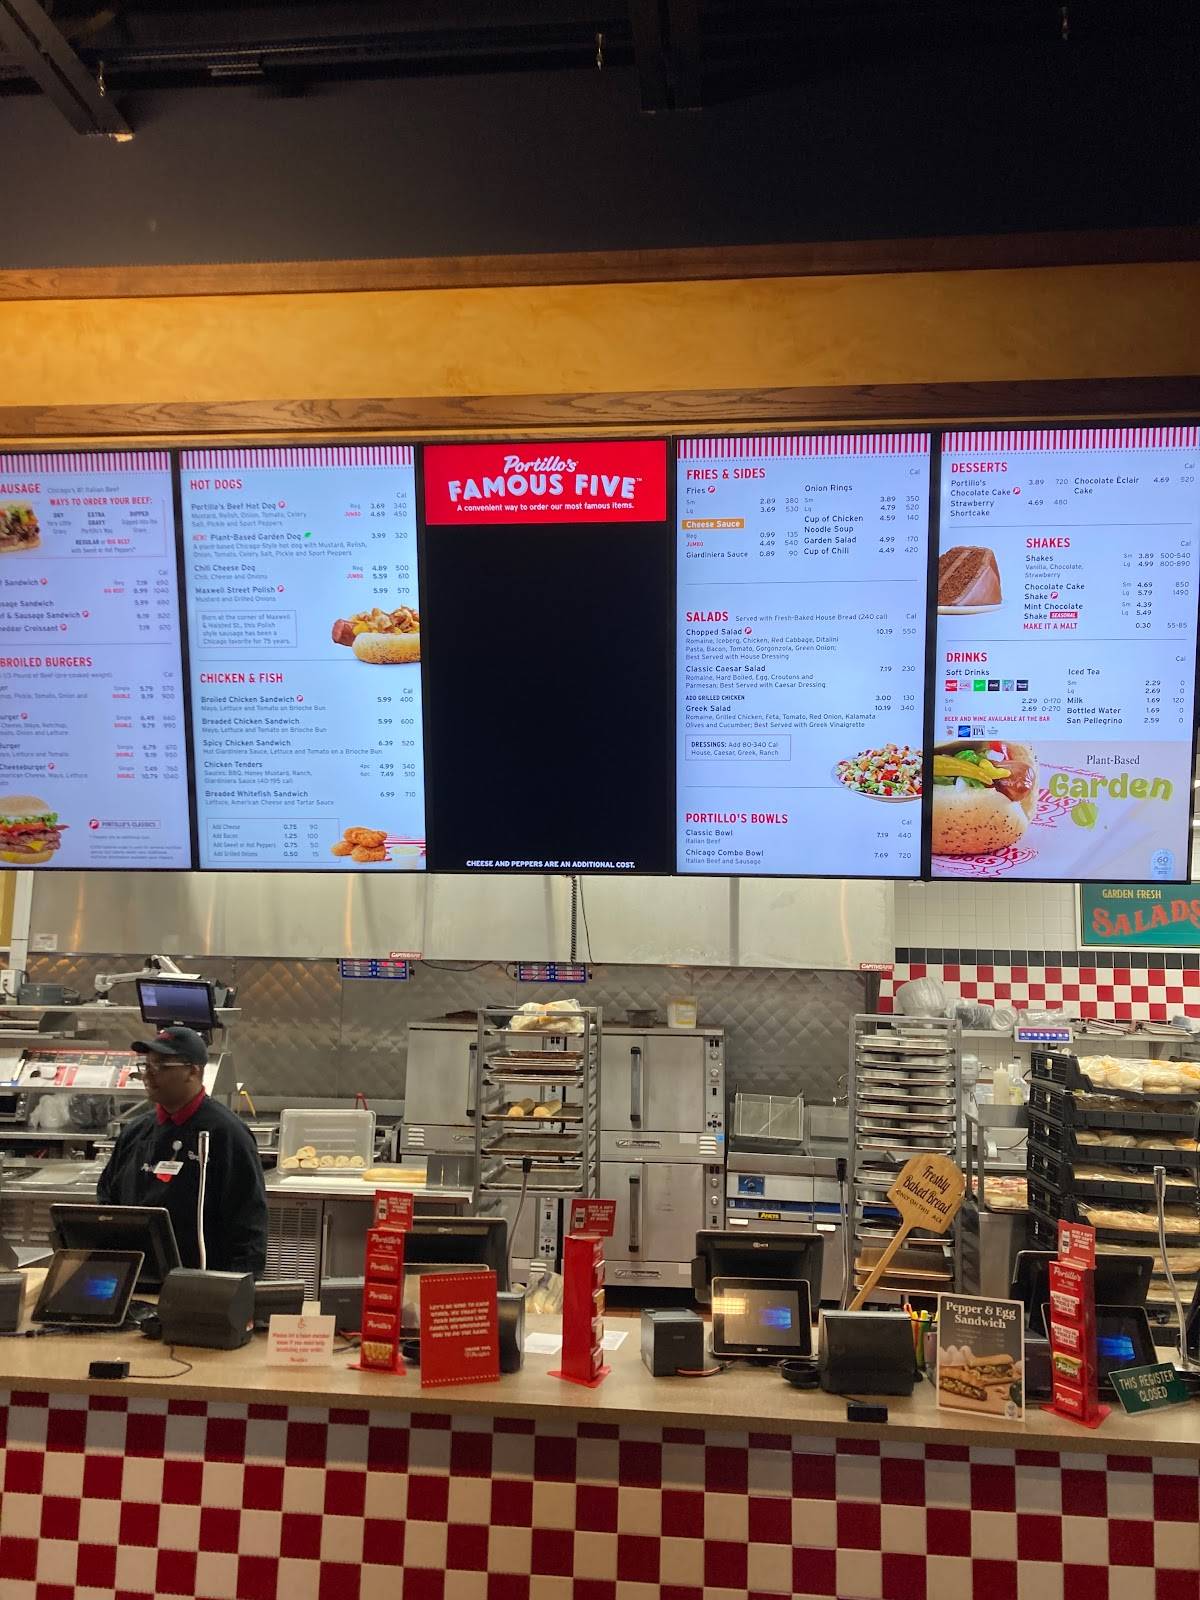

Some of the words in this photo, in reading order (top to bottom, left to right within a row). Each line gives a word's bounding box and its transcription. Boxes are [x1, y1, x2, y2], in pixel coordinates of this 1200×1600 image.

[504, 455, 577, 474] Portillo's
[952, 463, 1008, 472] DESSERTS
[687, 470, 718, 480] FRIES
[722, 469, 729, 479] &
[734, 468, 765, 478] SIDES
[191, 480, 210, 490] HOT
[215, 480, 242, 489] DOGS
[448, 474, 563, 501] FAMOUS
[952, 479, 986, 487] Portillo's
[992, 488, 1011, 496] Cake
[1074, 487, 1092, 495] Cake
[50, 497, 69, 506] WAYS
[83, 497, 107, 505] ORDER
[110, 497, 129, 505] YOUR
[950, 500, 994, 508] Strawberry
[504, 504, 518, 512] way
[950, 509, 989, 517] Shortcake
[805, 515, 820, 523] Cup
[1026, 538, 1070, 548] SHAKES
[241, 564, 255, 572] Dog
[686, 612, 729, 622] SALADS
[686, 628, 718, 636] Chopped
[46, 657, 92, 666] BURGERS
[947, 653, 987, 662] DRINKS
[200, 674, 245, 683] CHICKEN
[250, 674, 255, 682] &
[259, 674, 283, 682] FISH
[1087, 755, 1140, 765] Plant-Based
[1050, 773, 1173, 801] Garden
[686, 813, 747, 823] PORTILLO'S
[751, 814, 788, 824] BOWLS
[1103, 889, 1133, 898] GARDEN
[1136, 890, 1161, 899] FRESH
[923, 1165, 950, 1194] Freshly
[903, 1175, 929, 1199] Baked
[926, 1191, 952, 1215] Bread
[946, 1301, 982, 1314] Pepper
[985, 1307, 993, 1315] &
[995, 1307, 1016, 1321] Egg
[955, 1314, 1006, 1329] Sandwich
[1119, 1378, 1137, 1389] THIS
[1139, 1370, 1174, 1386] REGISTER
[1139, 1387, 1167, 1402] CLOSED
